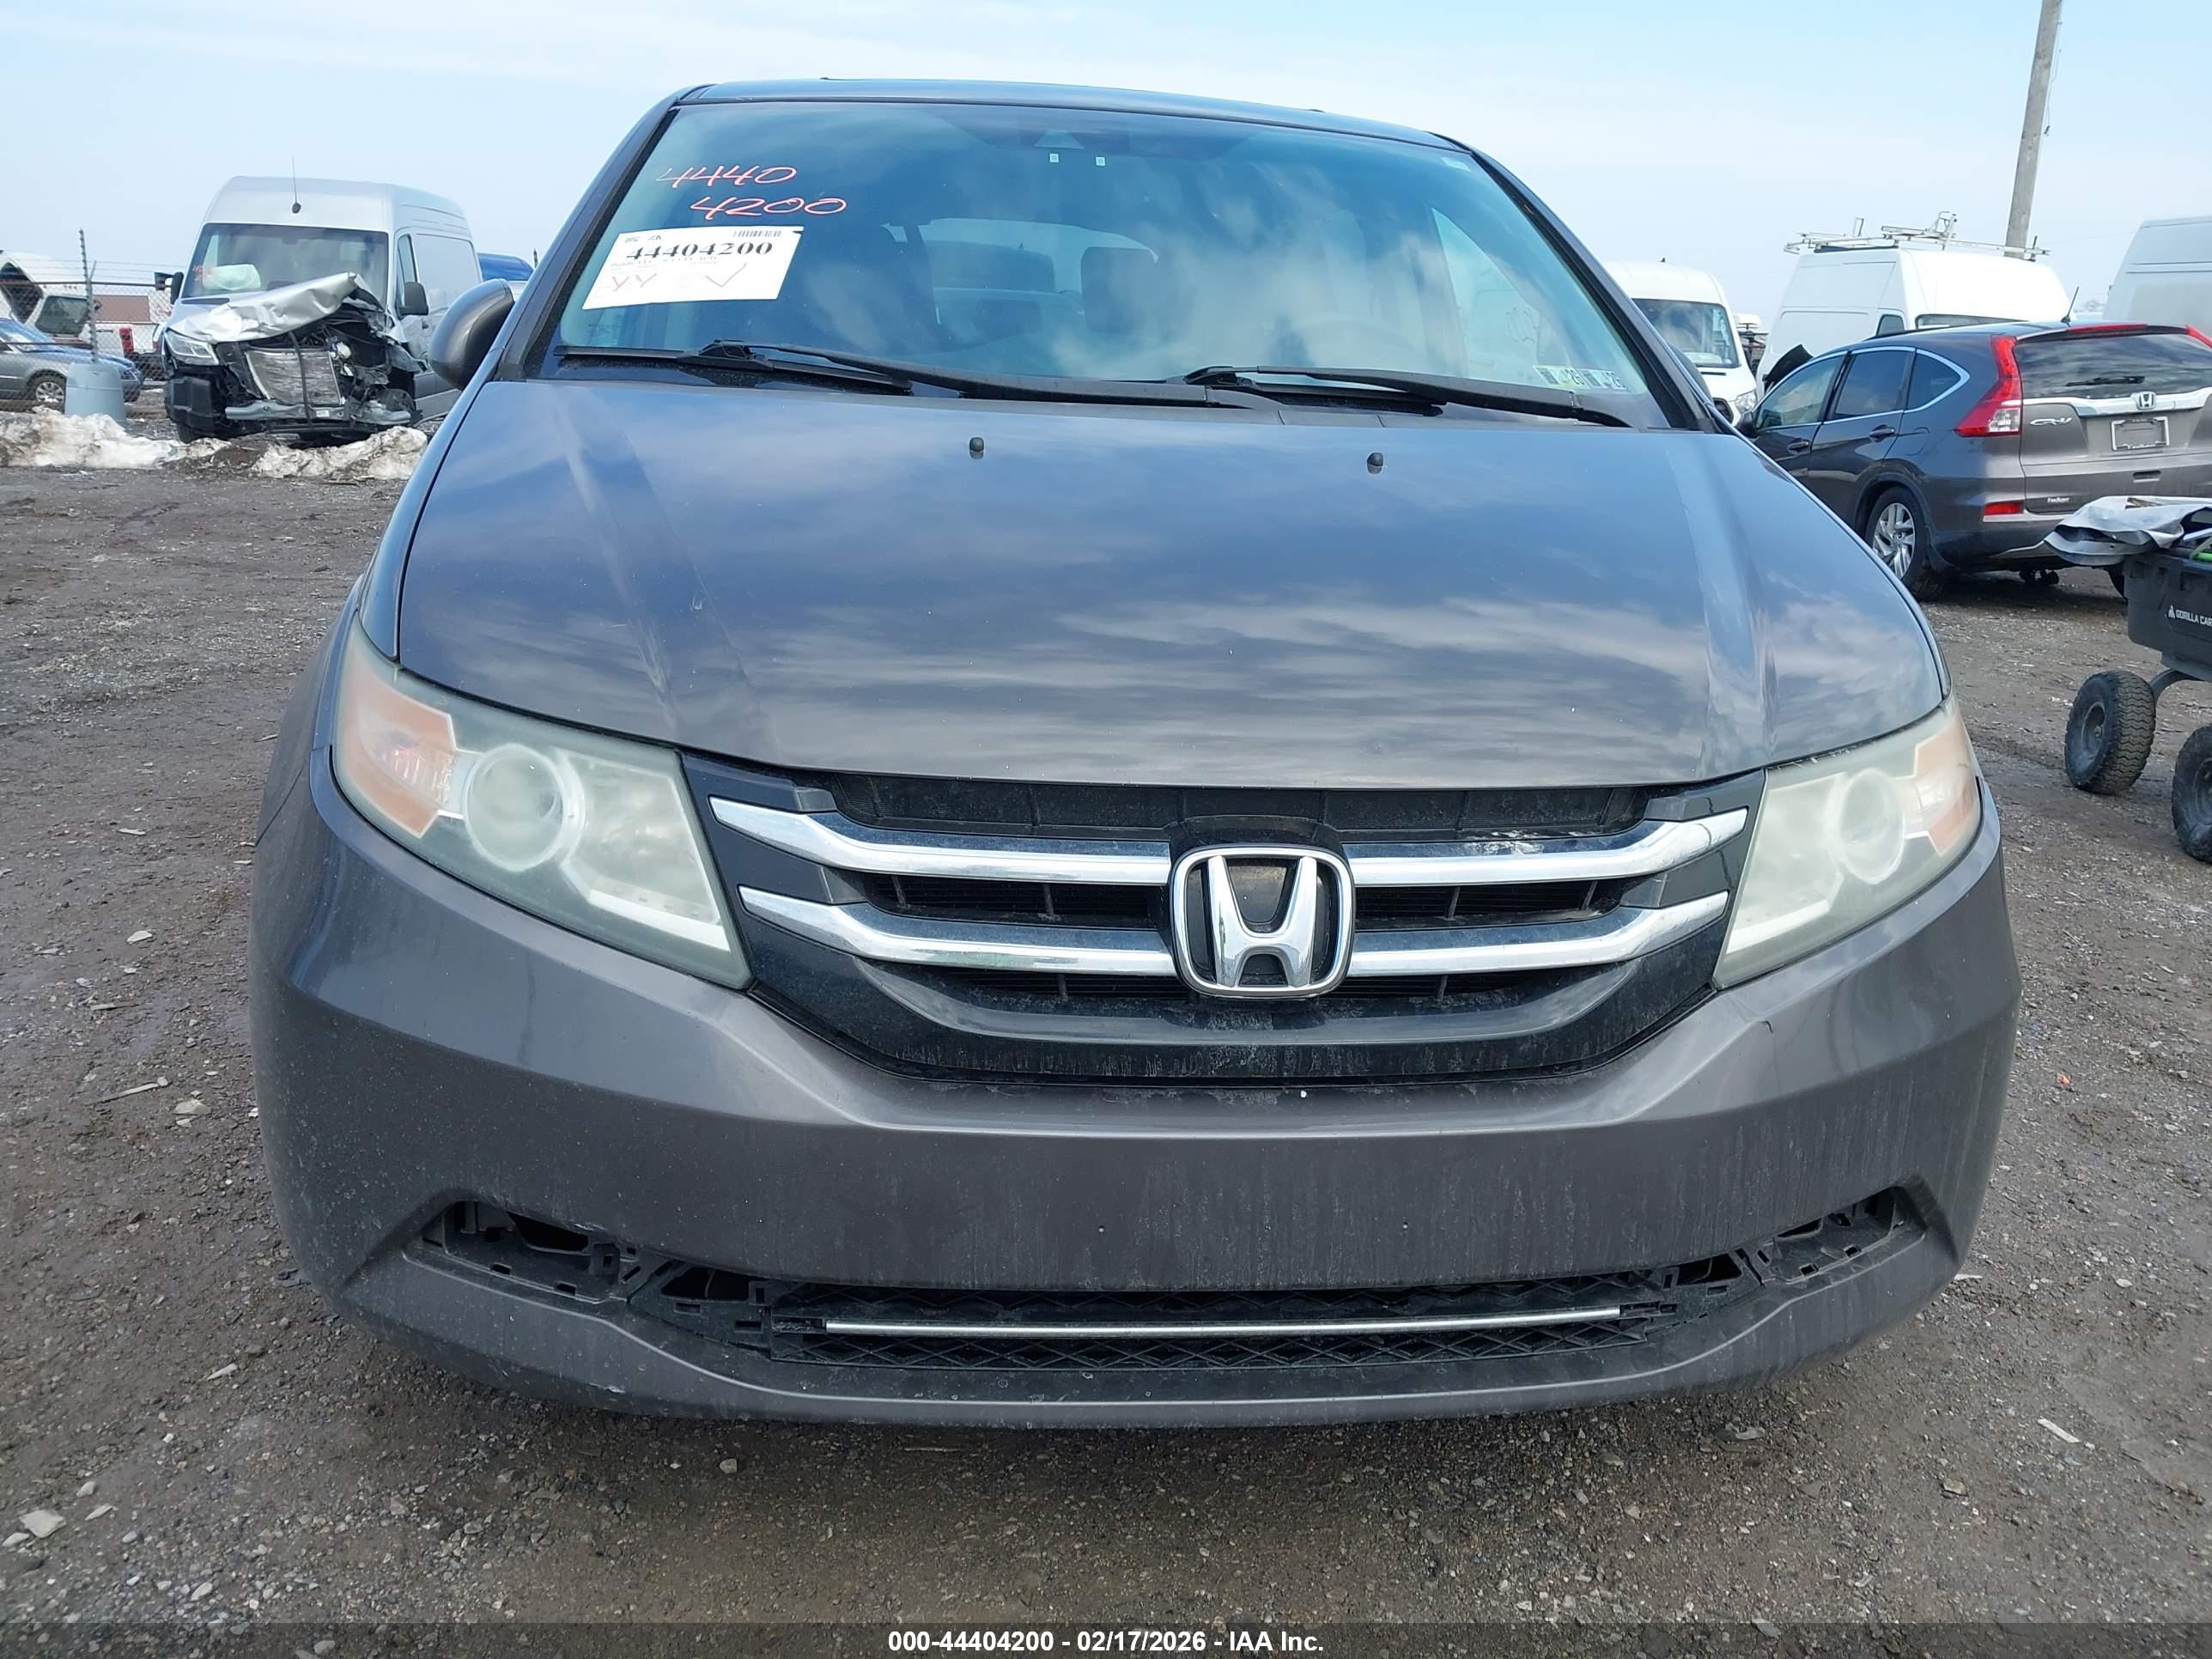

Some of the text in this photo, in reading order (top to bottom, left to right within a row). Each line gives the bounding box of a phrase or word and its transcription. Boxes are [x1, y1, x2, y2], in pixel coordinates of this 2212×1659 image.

[655, 165, 797, 188] 4440
[690, 197, 848, 220] 4200
[626, 241, 773, 259] 44404200
[2175, 609, 2200, 624] GORILLA
